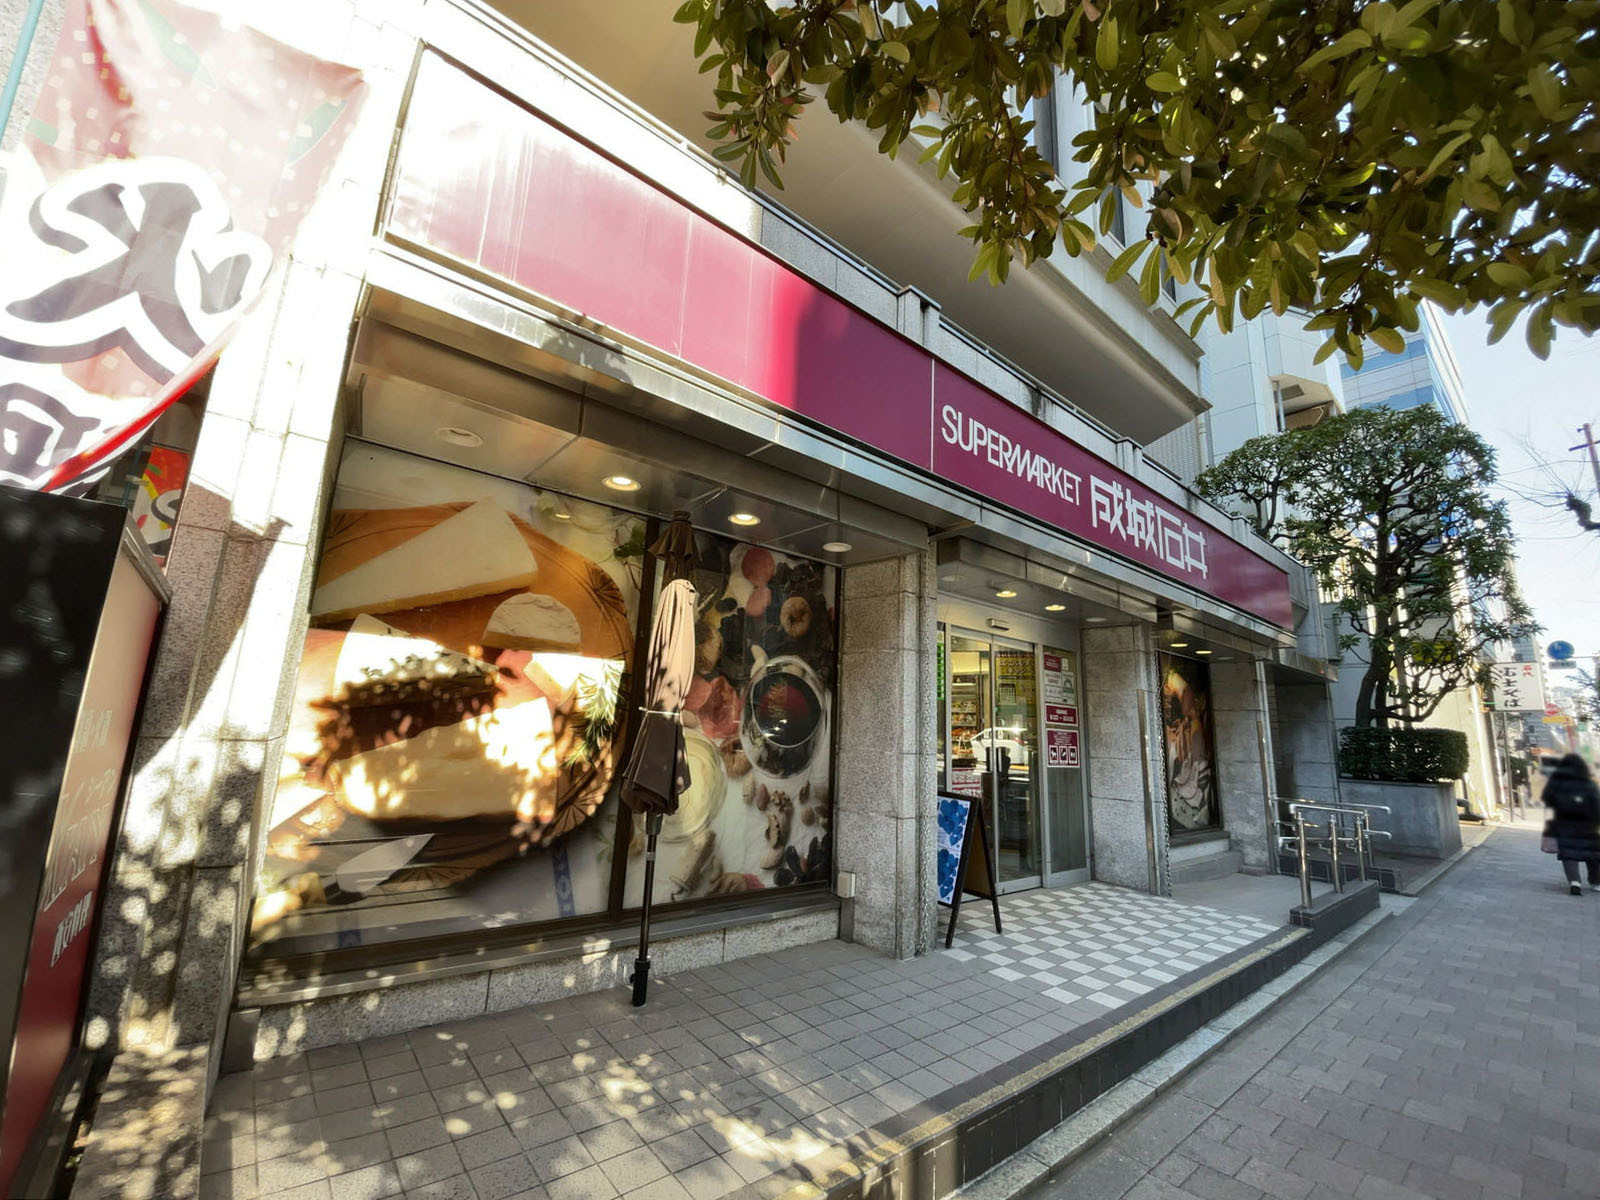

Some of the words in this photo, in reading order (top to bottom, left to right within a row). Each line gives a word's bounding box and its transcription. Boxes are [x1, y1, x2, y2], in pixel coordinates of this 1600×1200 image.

[941, 404, 1082, 507] SUPERMARKET
[1090, 473, 1208, 580] 成城石井
